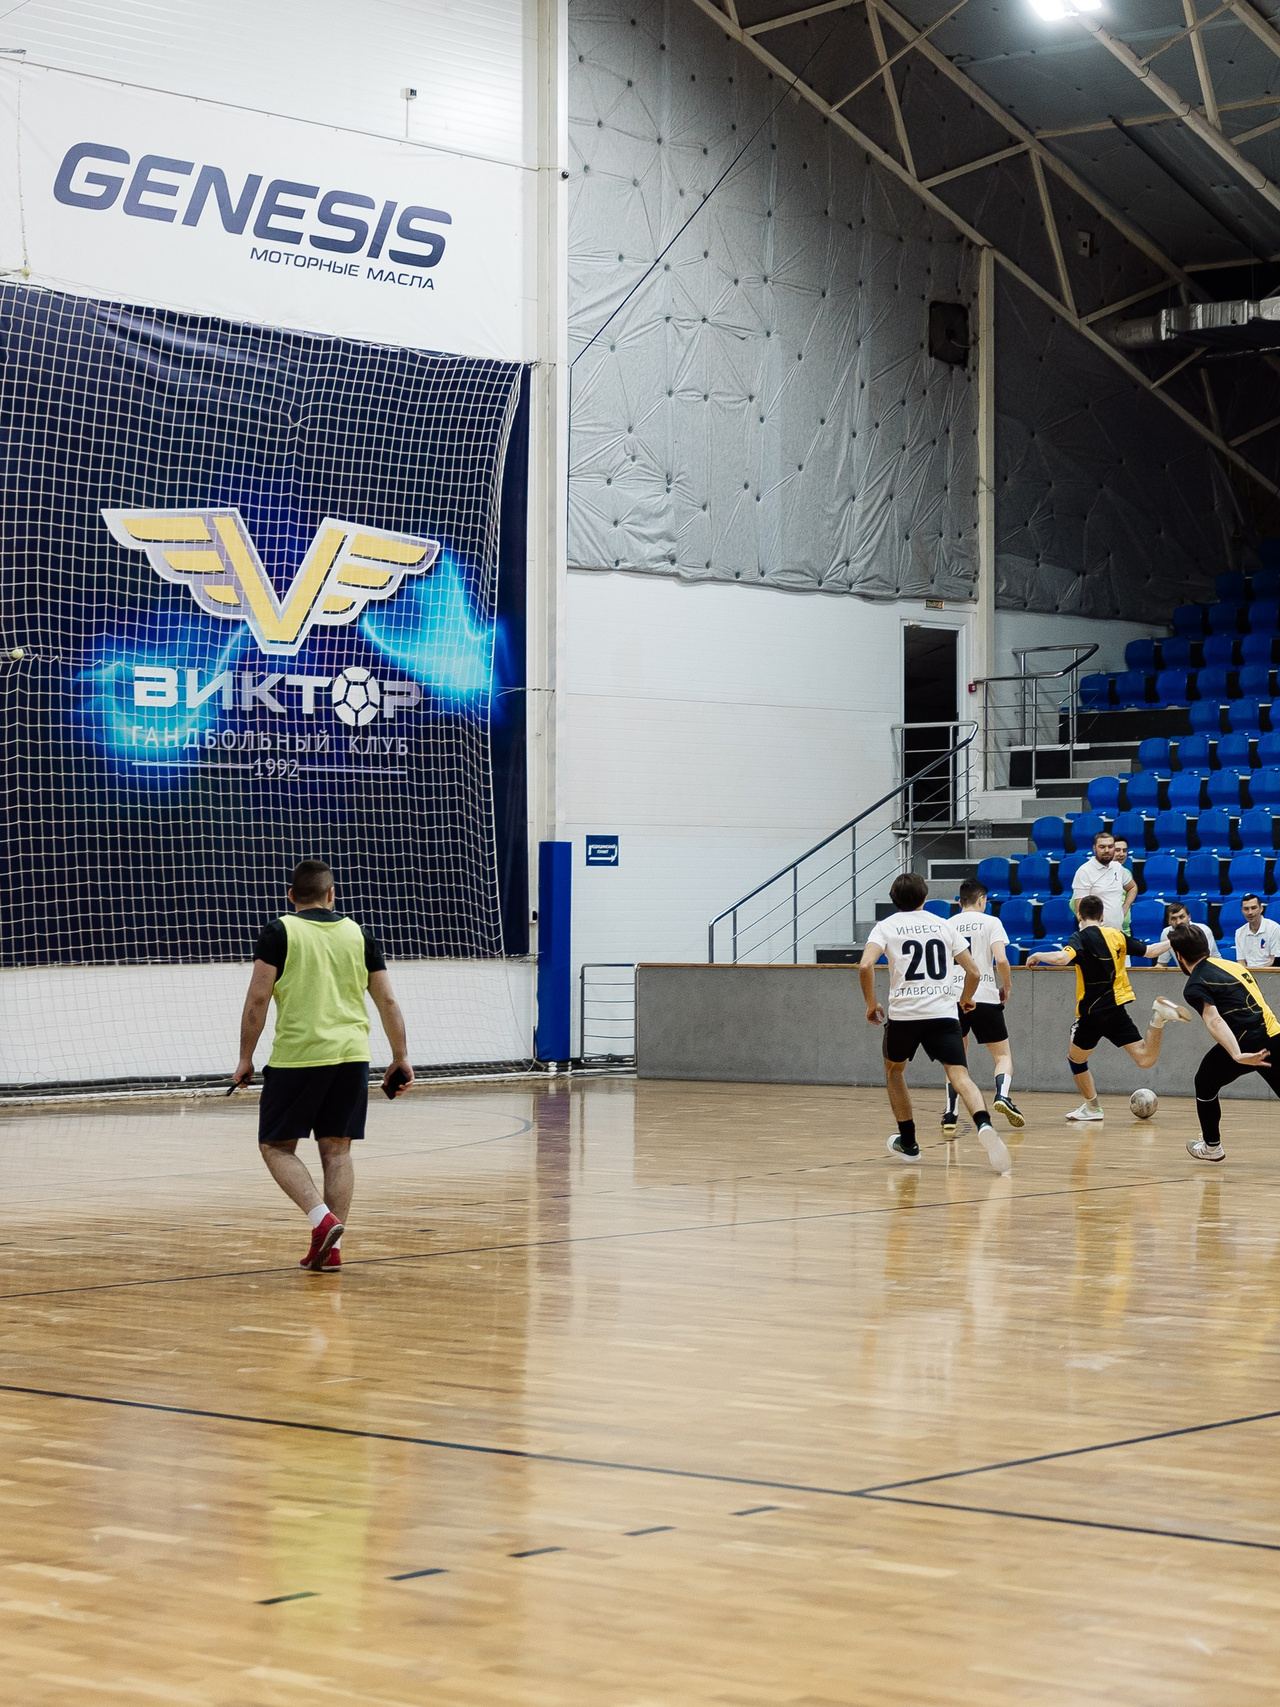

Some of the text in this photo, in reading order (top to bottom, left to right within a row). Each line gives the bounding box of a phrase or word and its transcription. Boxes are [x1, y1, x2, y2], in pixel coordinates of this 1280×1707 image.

[53, 142, 453, 269] GENESIS
[250, 247, 435, 291] МОТОРНЫЕ МАСЛА
[133, 665, 422, 728] ВИКТОР
[131, 725, 410, 757] ГАНДБОЛЬНЫЙ КЛУБ
[253, 756, 300, 779] 1992
[902, 938, 948, 982] 20
